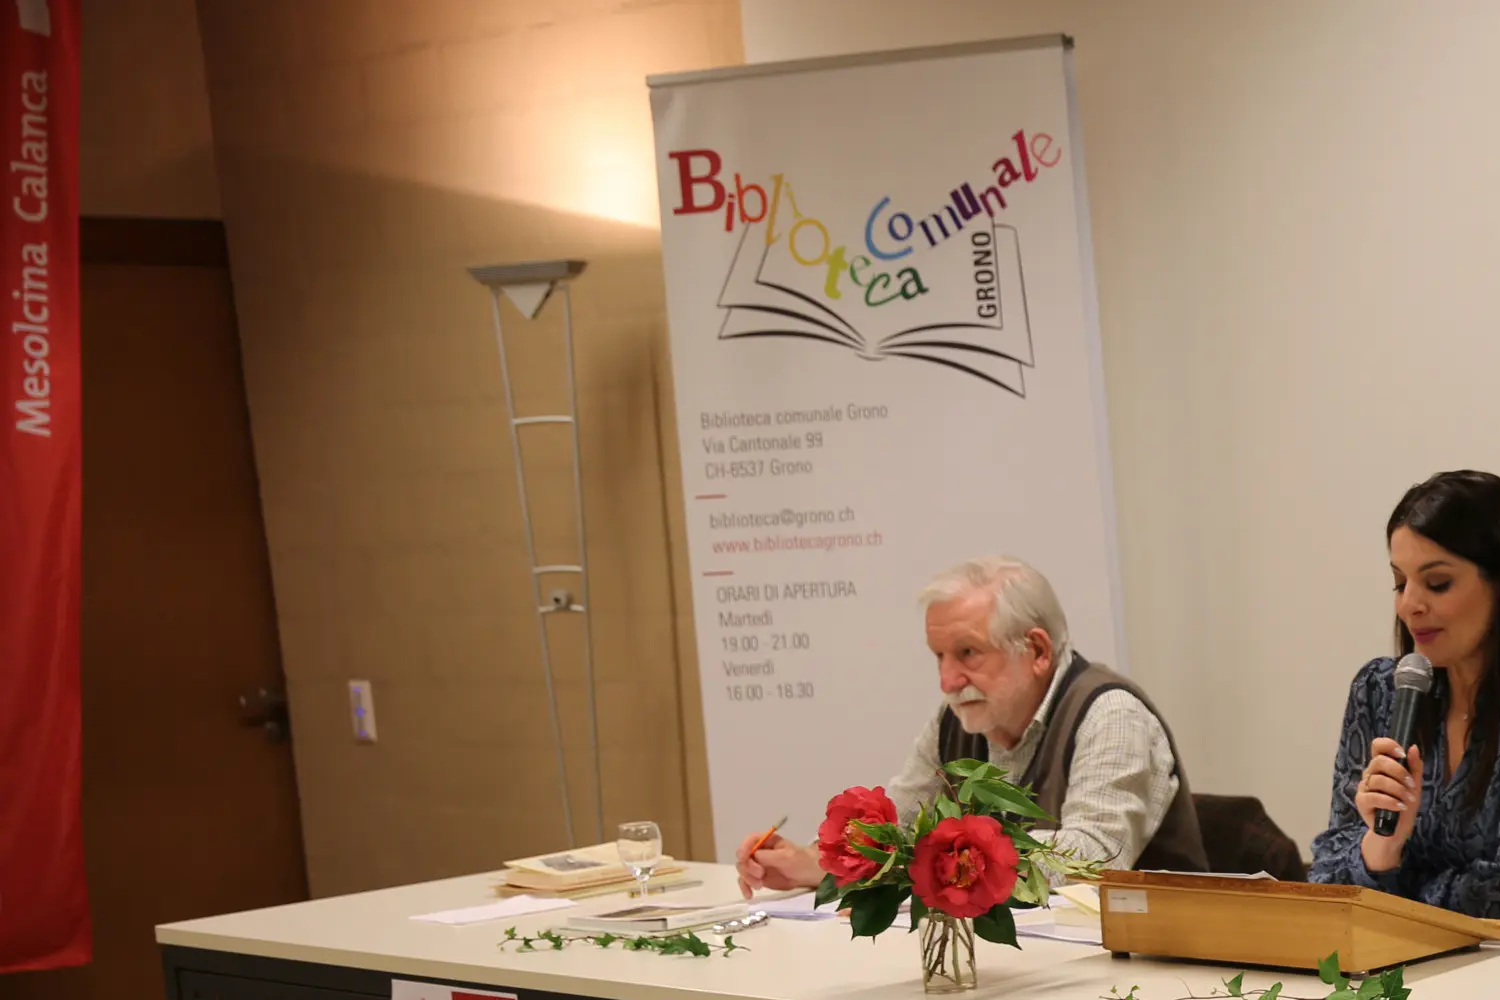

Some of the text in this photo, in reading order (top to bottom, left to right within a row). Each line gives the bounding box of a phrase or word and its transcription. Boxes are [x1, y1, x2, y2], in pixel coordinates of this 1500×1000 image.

[865, 129, 1062, 261] Comunale
[11, 69, 52, 437] Mesolcina Calanca
[972, 231, 998, 319] GRONO
[700, 403, 888, 429] Biblioteca comunale Grono
[702, 432, 824, 454] Via Cantonale 99
[705, 458, 813, 479] CH-6537 Grono
[716, 580, 857, 603] ORARI DI APERTURA
